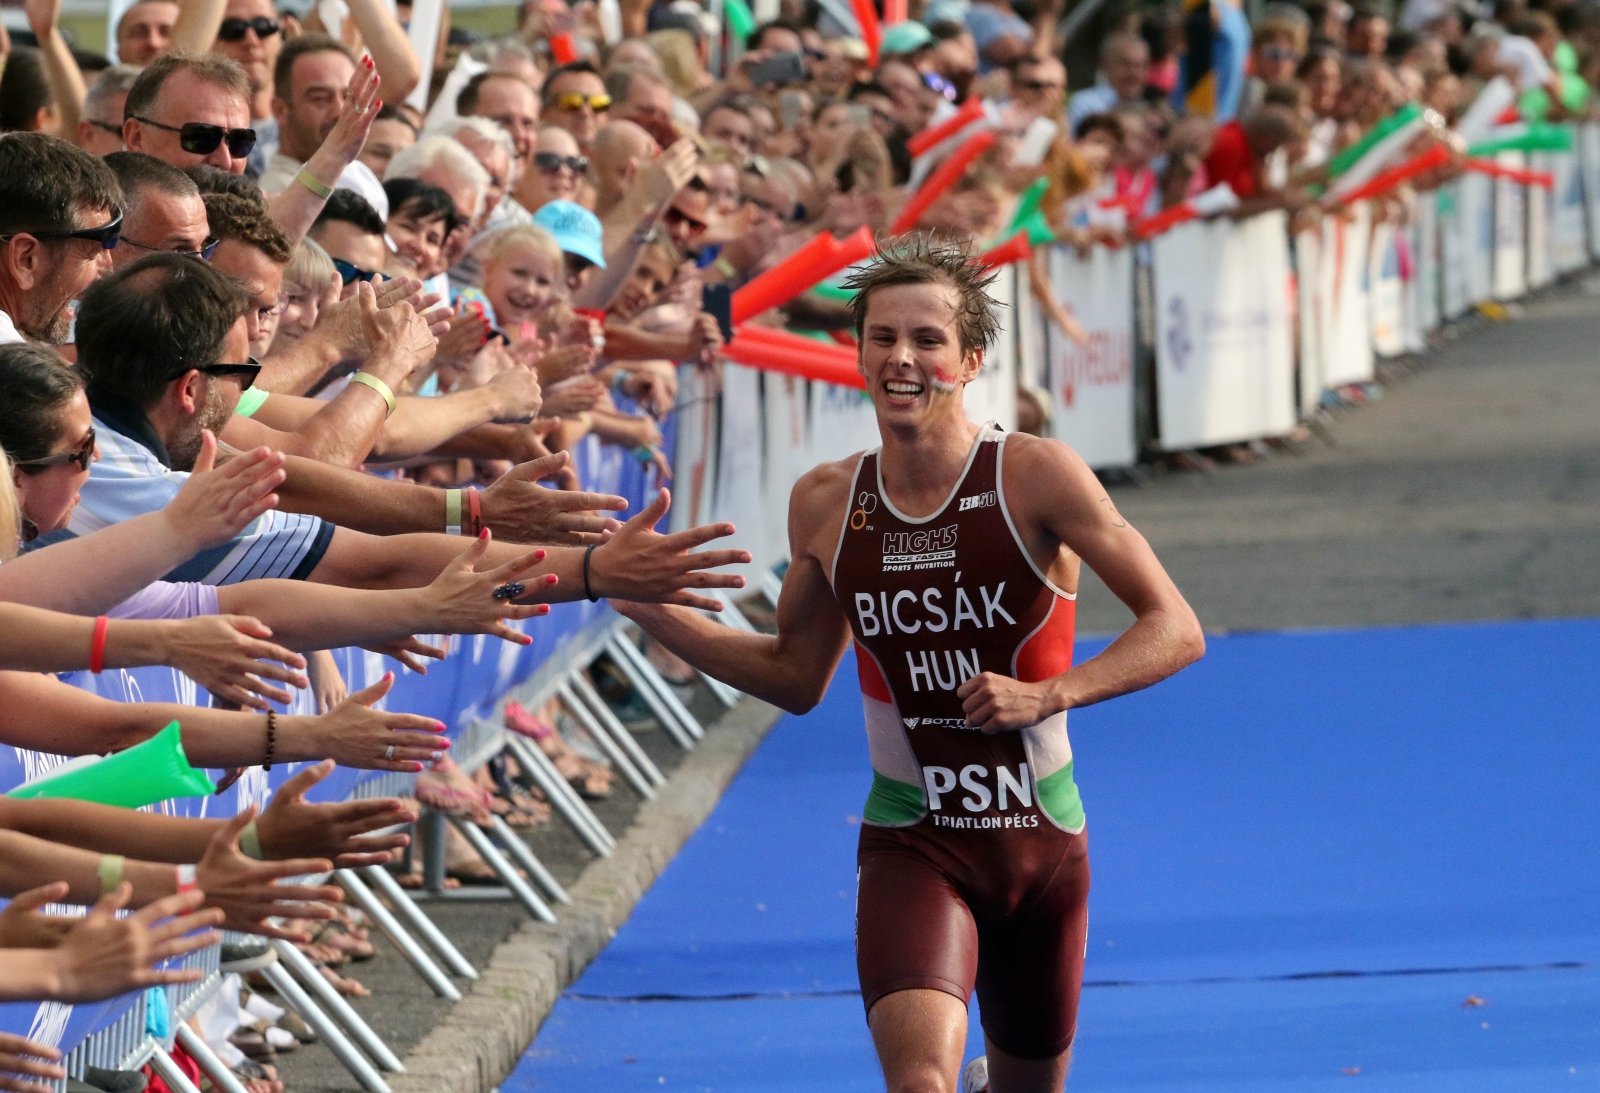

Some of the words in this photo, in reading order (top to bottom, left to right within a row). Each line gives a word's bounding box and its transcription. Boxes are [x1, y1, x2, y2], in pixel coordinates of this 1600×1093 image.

[882, 564, 912, 572] SPORTS
[914, 560, 955, 570] NUTRITION
[915, 551, 953, 560] FASTER
[855, 570, 1017, 637] BICSÁK
[905, 648, 981, 692] HUN
[922, 762, 1033, 813] PSN
[932, 814, 1002, 829] TRIATLON
[1004, 813, 1039, 829] PÉCS
